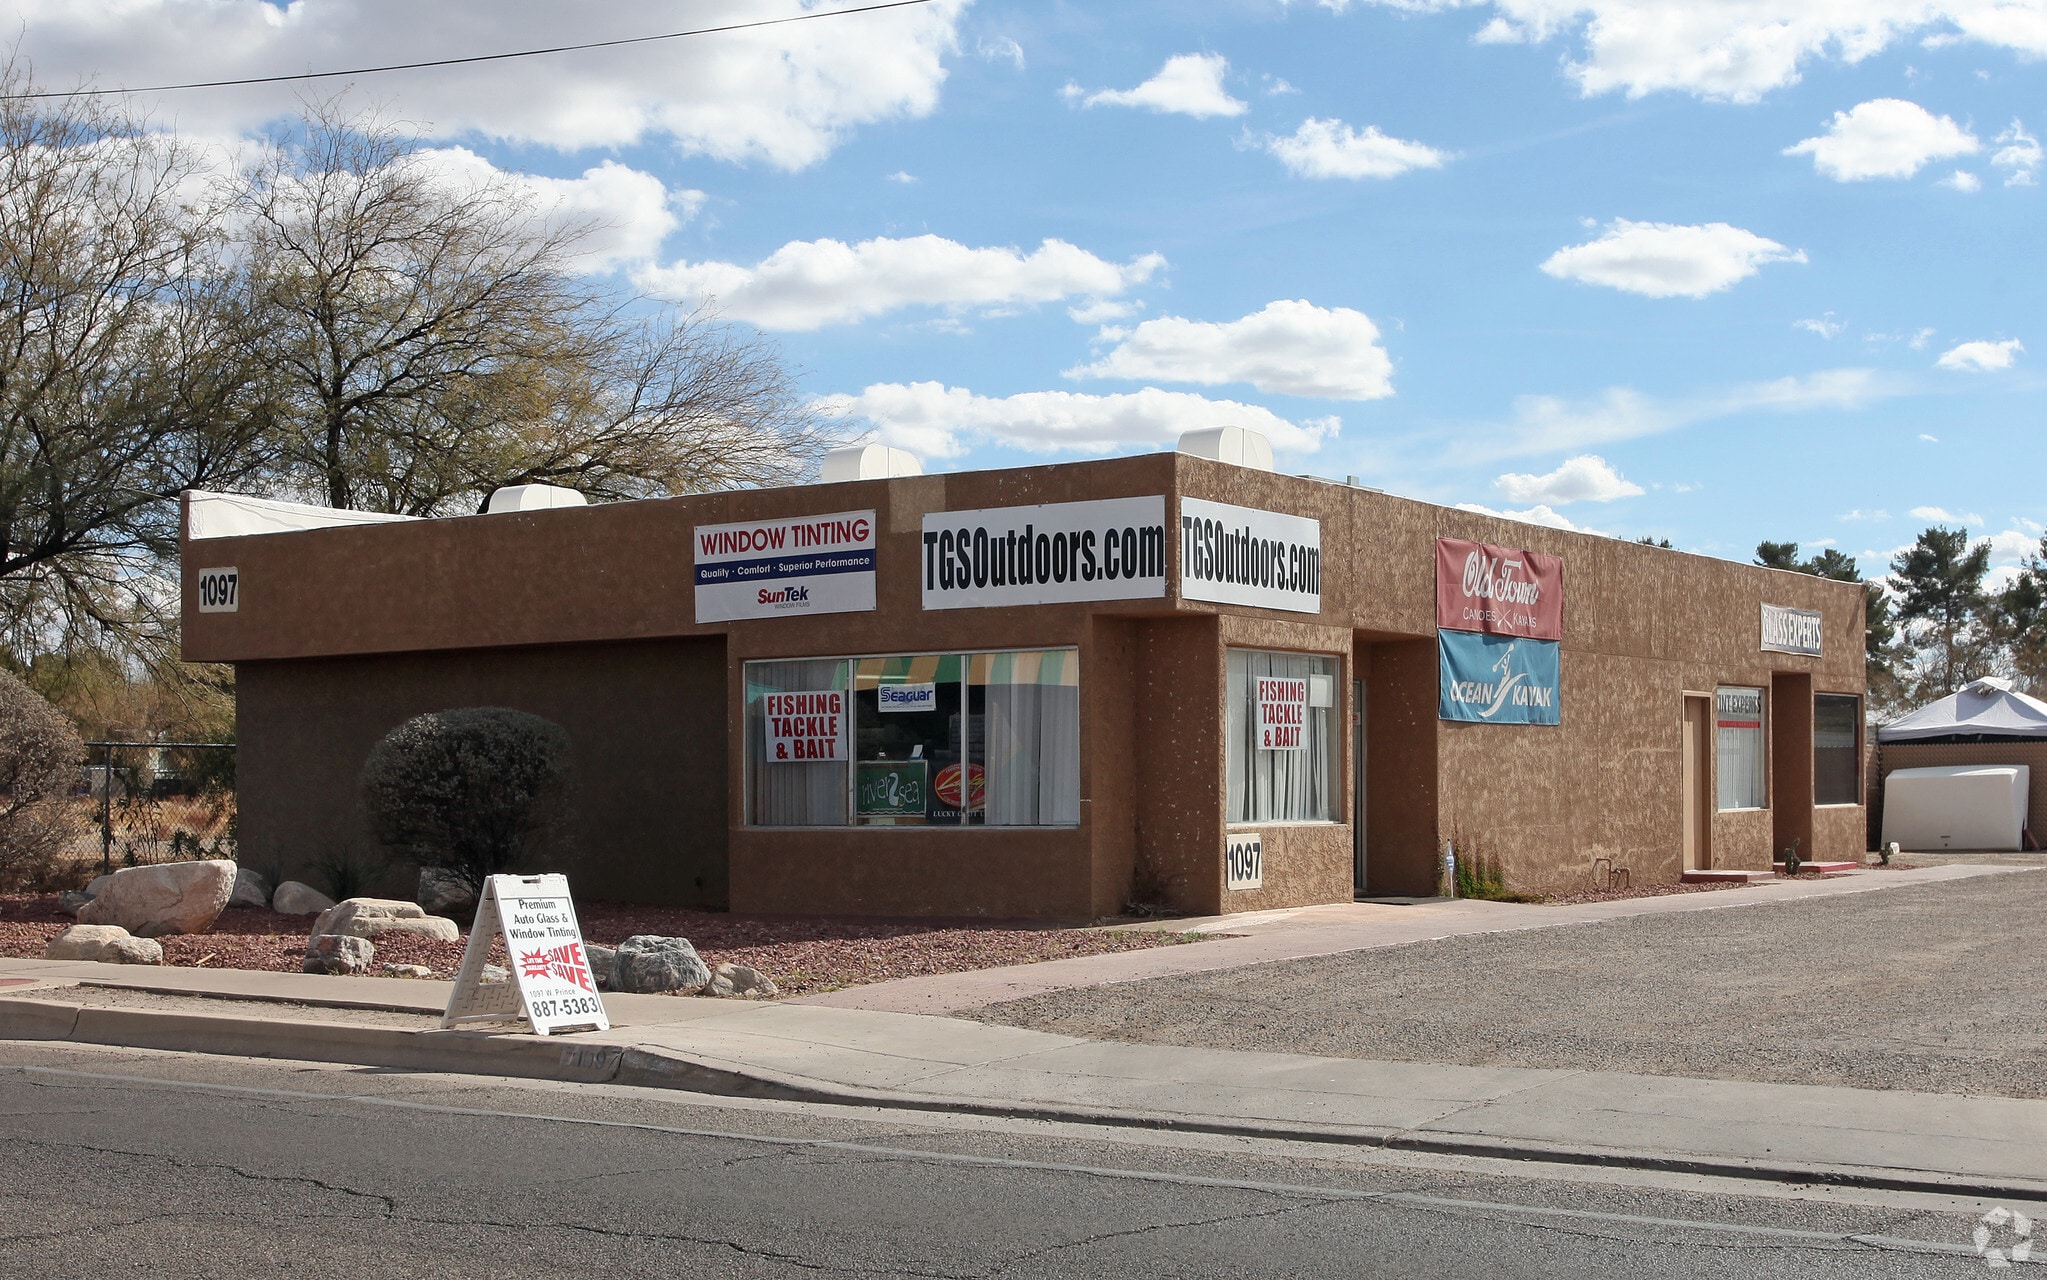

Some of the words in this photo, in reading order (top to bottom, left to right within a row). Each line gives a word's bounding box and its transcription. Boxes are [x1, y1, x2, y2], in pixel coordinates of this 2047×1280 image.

[700, 526, 786, 556] WINDOW
[791, 518, 870, 548] TINTING
[923, 524, 1165, 591] TGSOutdoors.com
[1182, 516, 1320, 595] TGSOutdoors.com
[700, 568, 730, 579] Quality
[737, 564, 771, 575] Comfort
[778, 556, 813, 572] Superior
[815, 556, 870, 569] Performance
[1462, 550, 1497, 599] Old
[1494, 558, 1539, 605] Town
[201, 574, 238, 606] 1097
[757, 586, 810, 605] SunTek
[1462, 606, 1497, 622] CANOES
[1513, 611, 1537, 628] KAYAKS
[1763, 611, 1788, 645] GLASS
[1788, 613, 1821, 650] EXPERTS
[1259, 680, 1304, 702] FISHING
[1450, 679, 1493, 705] OCEAN
[1512, 684, 1553, 707] KAYAK
[767, 693, 841, 715] FISHING
[1262, 703, 1302, 724] TACKLE
[1718, 694, 1732, 713] INT
[1732, 695, 1761, 714] EXPERTS
[771, 716, 838, 737] TACKLE
[1264, 729, 1272, 748] &
[1274, 726, 1301, 747] BAIT
[775, 742, 789, 760] &
[793, 738, 836, 759] BAIT
[1229, 842, 1261, 881] 1097
[518, 898, 556, 909] Premium
[514, 914, 535, 925] Auto
[536, 912, 560, 923] Glass
[561, 913, 569, 923] &
[509, 928, 545, 939] Window
[546, 926, 577, 939] Tinting
[547, 942, 585, 966] SAVE
[551, 963, 593, 993] SAVE
[529, 989, 544, 998] 1097
[555, 988, 576, 996] Prince
